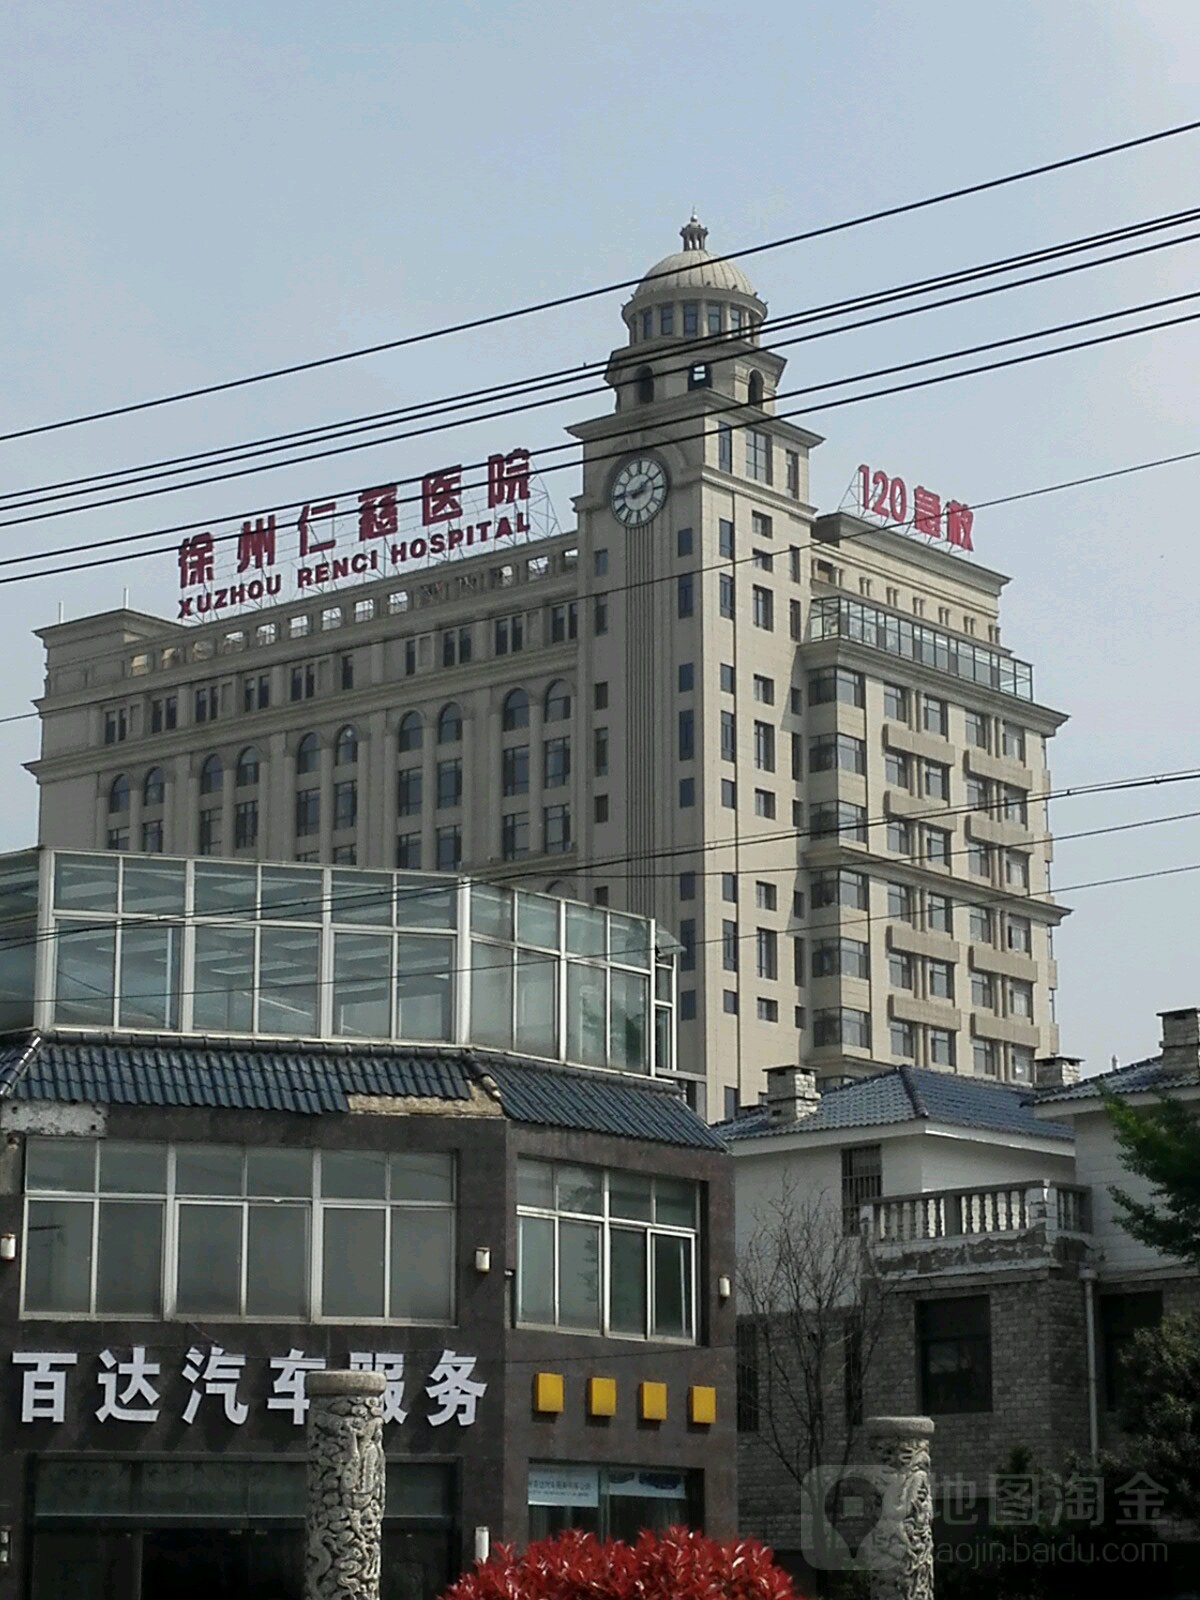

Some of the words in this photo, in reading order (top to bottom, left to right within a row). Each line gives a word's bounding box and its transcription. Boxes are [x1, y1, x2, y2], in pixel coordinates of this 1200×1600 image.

[177, 574, 282, 619] XUZHOU
[297, 551, 378, 589] RENCI
[391, 512, 531, 565] HOSPITAL
[178, 448, 531, 589] 徐州仁慈医院
